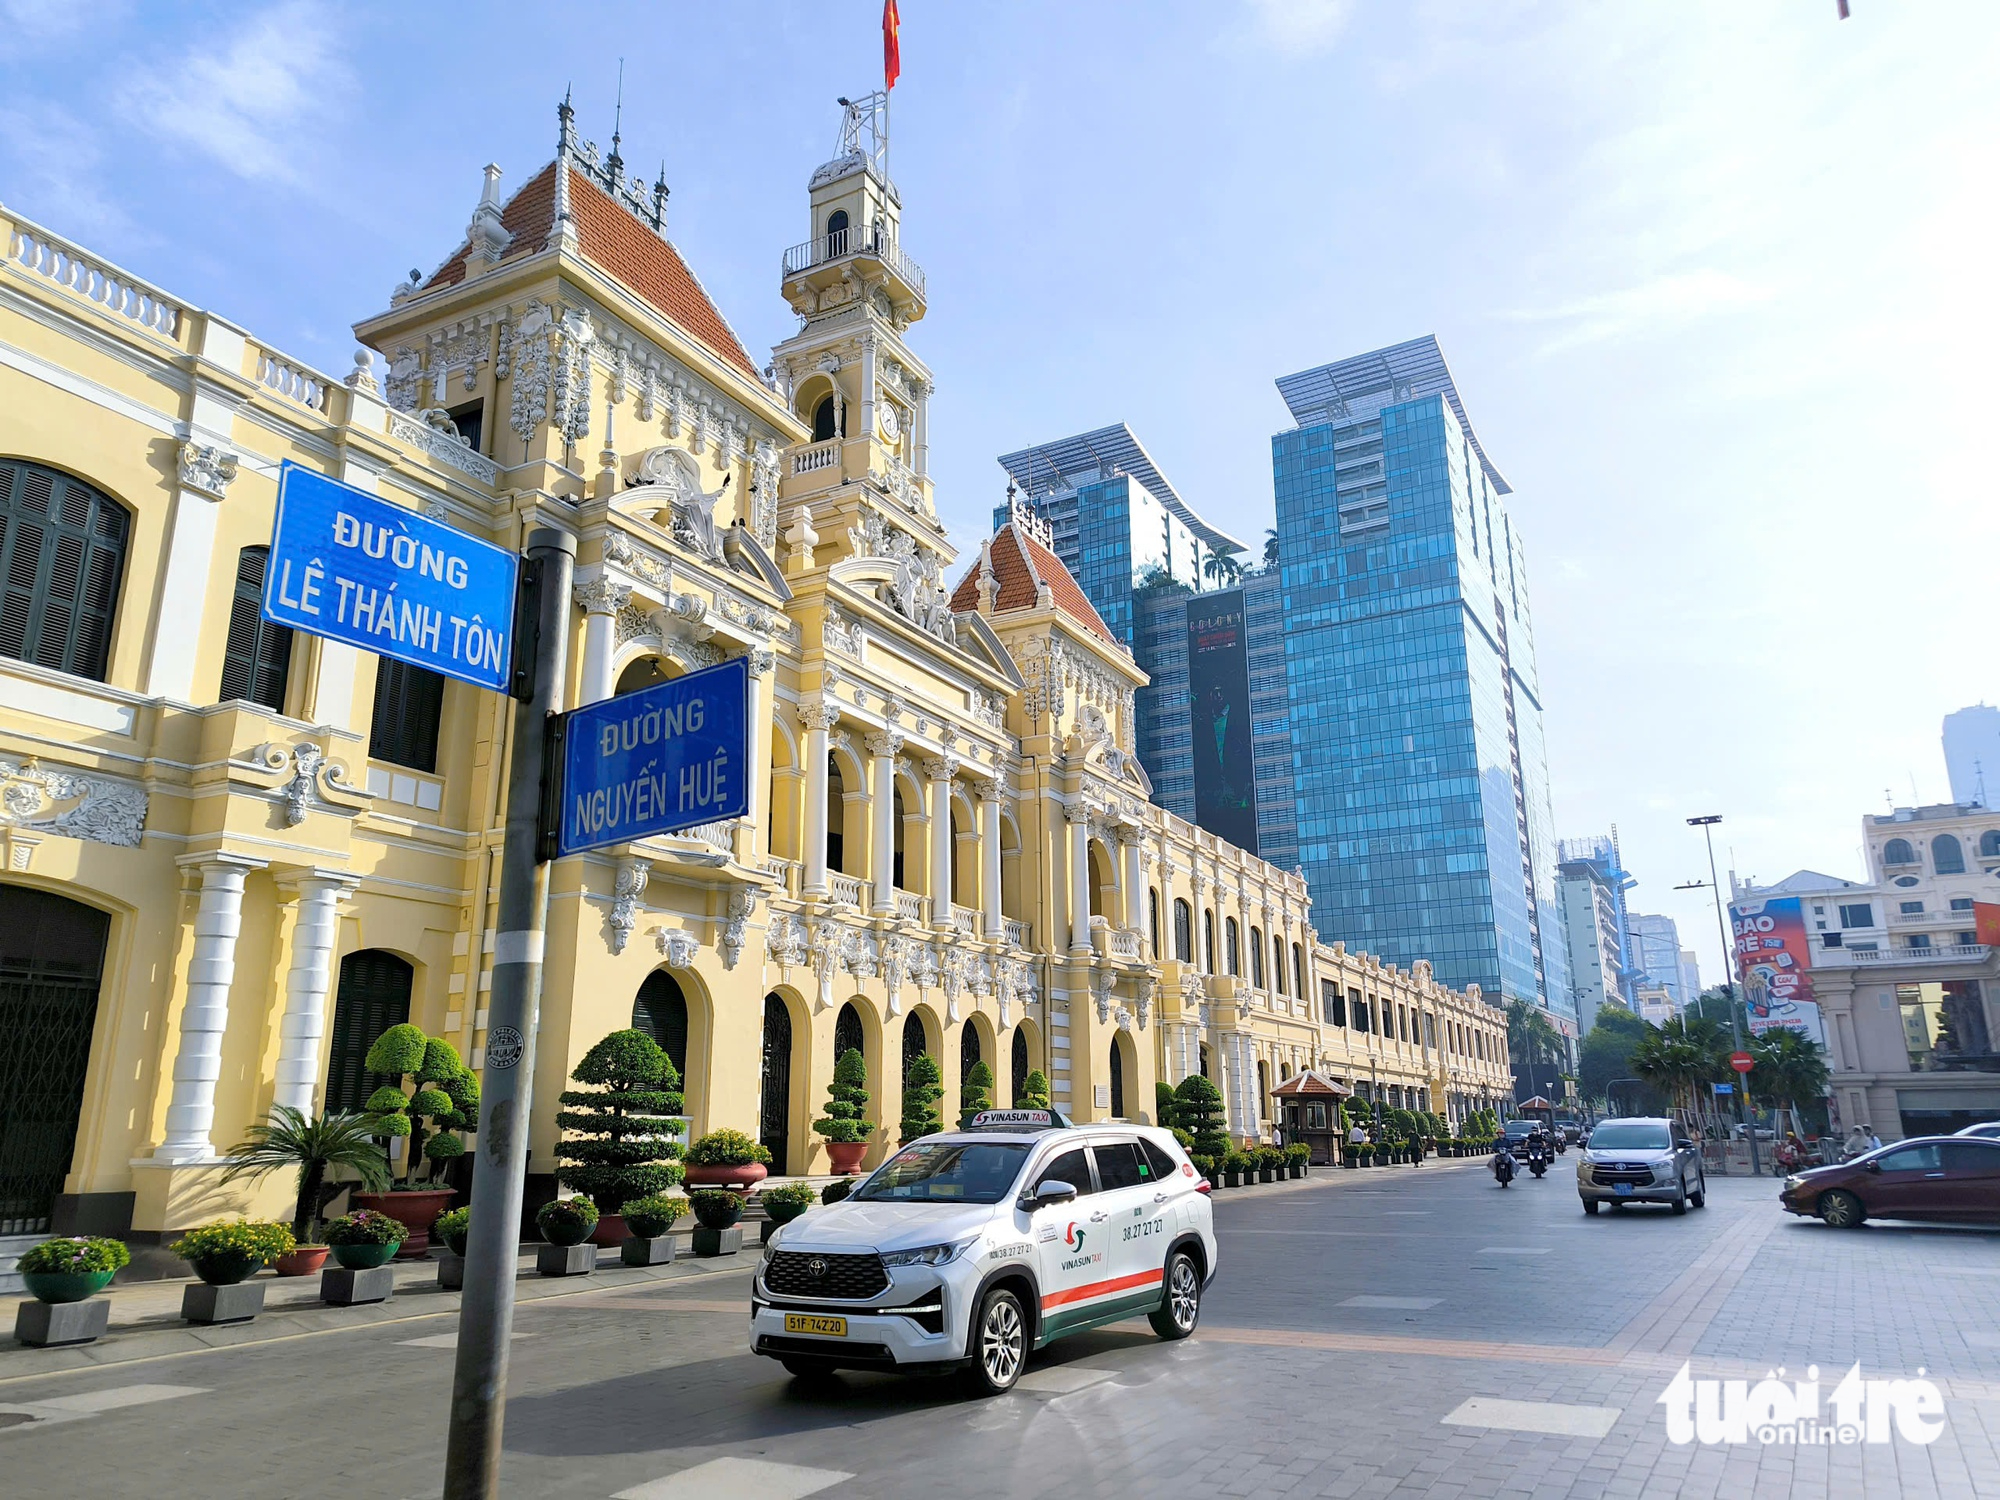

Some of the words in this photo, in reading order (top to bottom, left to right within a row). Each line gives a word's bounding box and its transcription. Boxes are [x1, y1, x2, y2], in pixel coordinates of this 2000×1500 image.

[332, 511, 469, 590] ĐƯỜNG
[278, 557, 326, 616] LÊ
[335, 576, 442, 653] THÁNH
[450, 613, 503, 674] TÔN
[600, 698, 704, 758] ĐƯỜNG
[576, 757, 666, 836] NGUYỄN
[679, 747, 728, 810] HUỆ
[991, 1113, 1029, 1121] VINASUN
[1032, 1113, 1049, 1122] TAXI
[1143, 1221, 1152, 1236] 27
[1154, 1219, 1163, 1233] 27
[1061, 1256, 1091, 1271] VINASUN
[1092, 1253, 1102, 1264] TAXI
